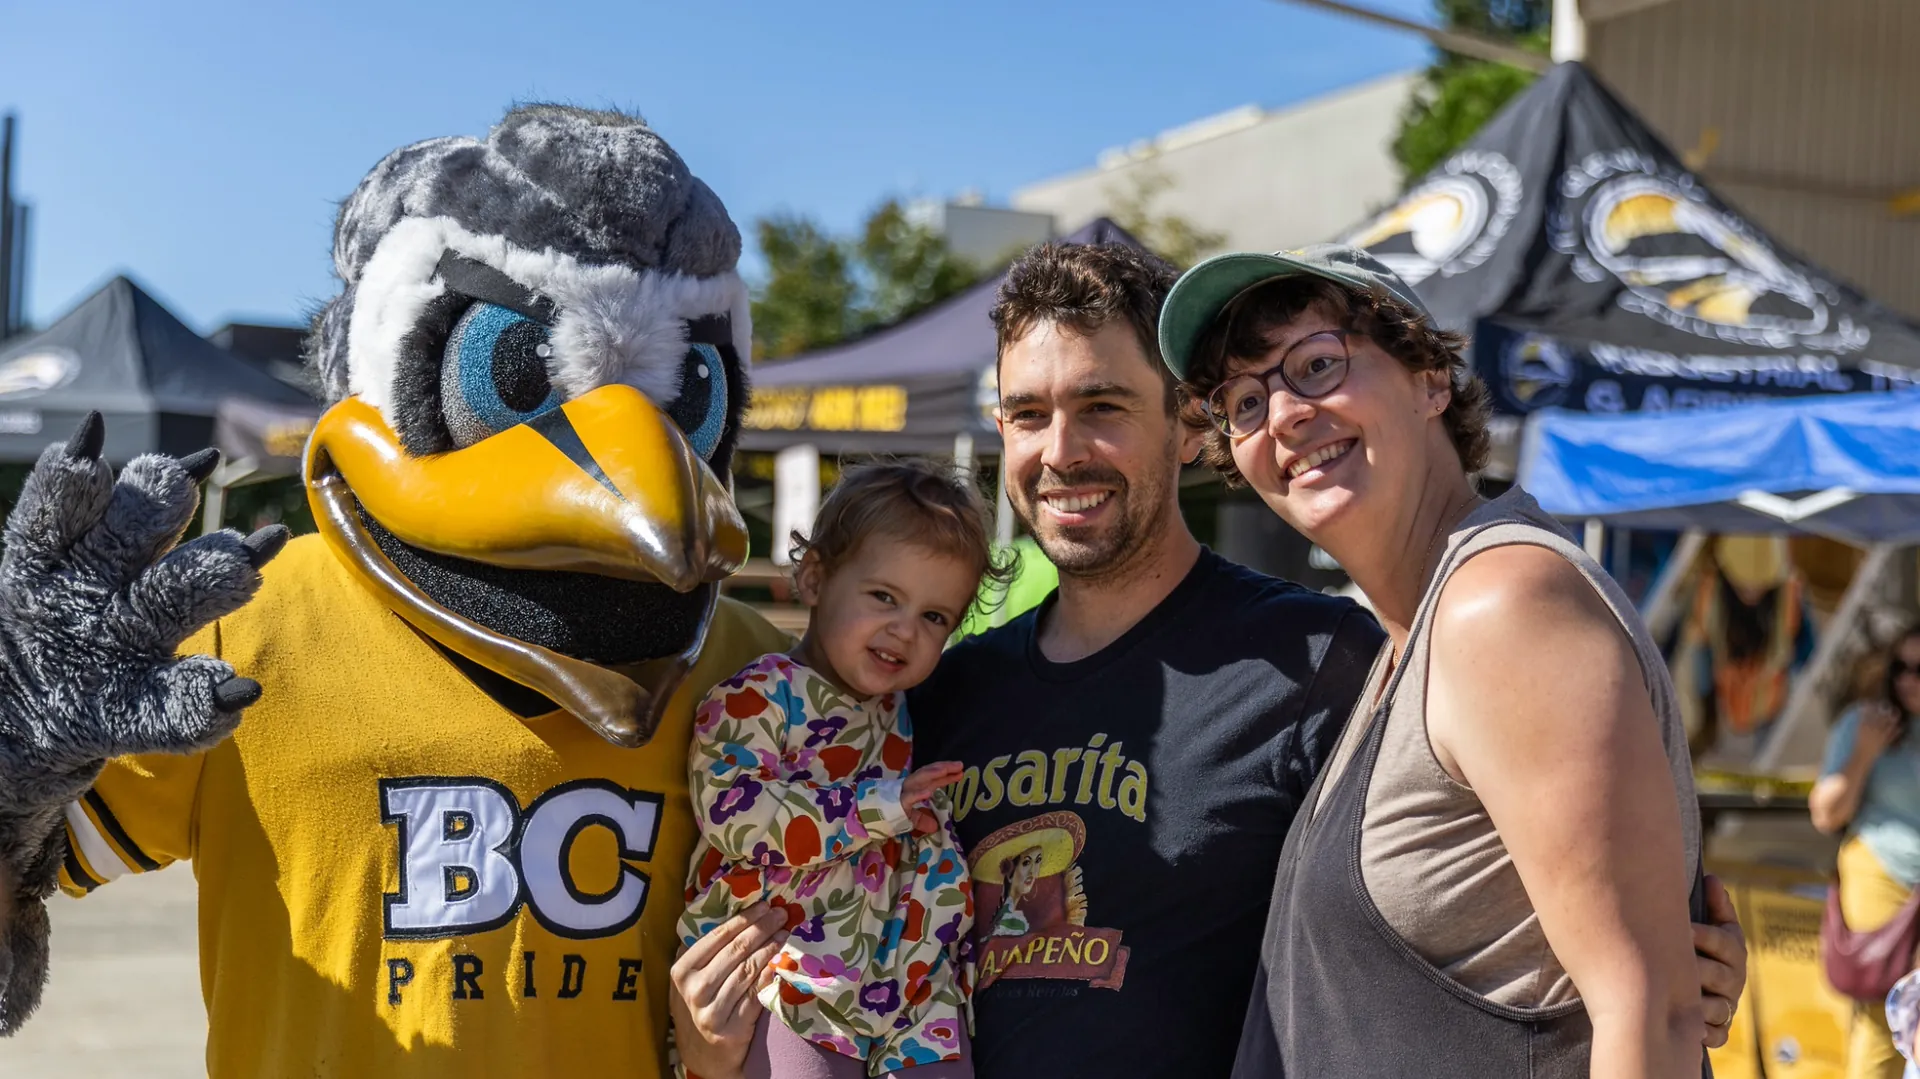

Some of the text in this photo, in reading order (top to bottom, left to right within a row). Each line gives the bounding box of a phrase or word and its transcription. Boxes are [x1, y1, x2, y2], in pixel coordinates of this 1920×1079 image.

[948, 733, 1148, 823] osarita
[379, 775, 665, 940] BC
[387, 951, 642, 1006] PRIDE
[980, 931, 1110, 979] ALAPEÑO
